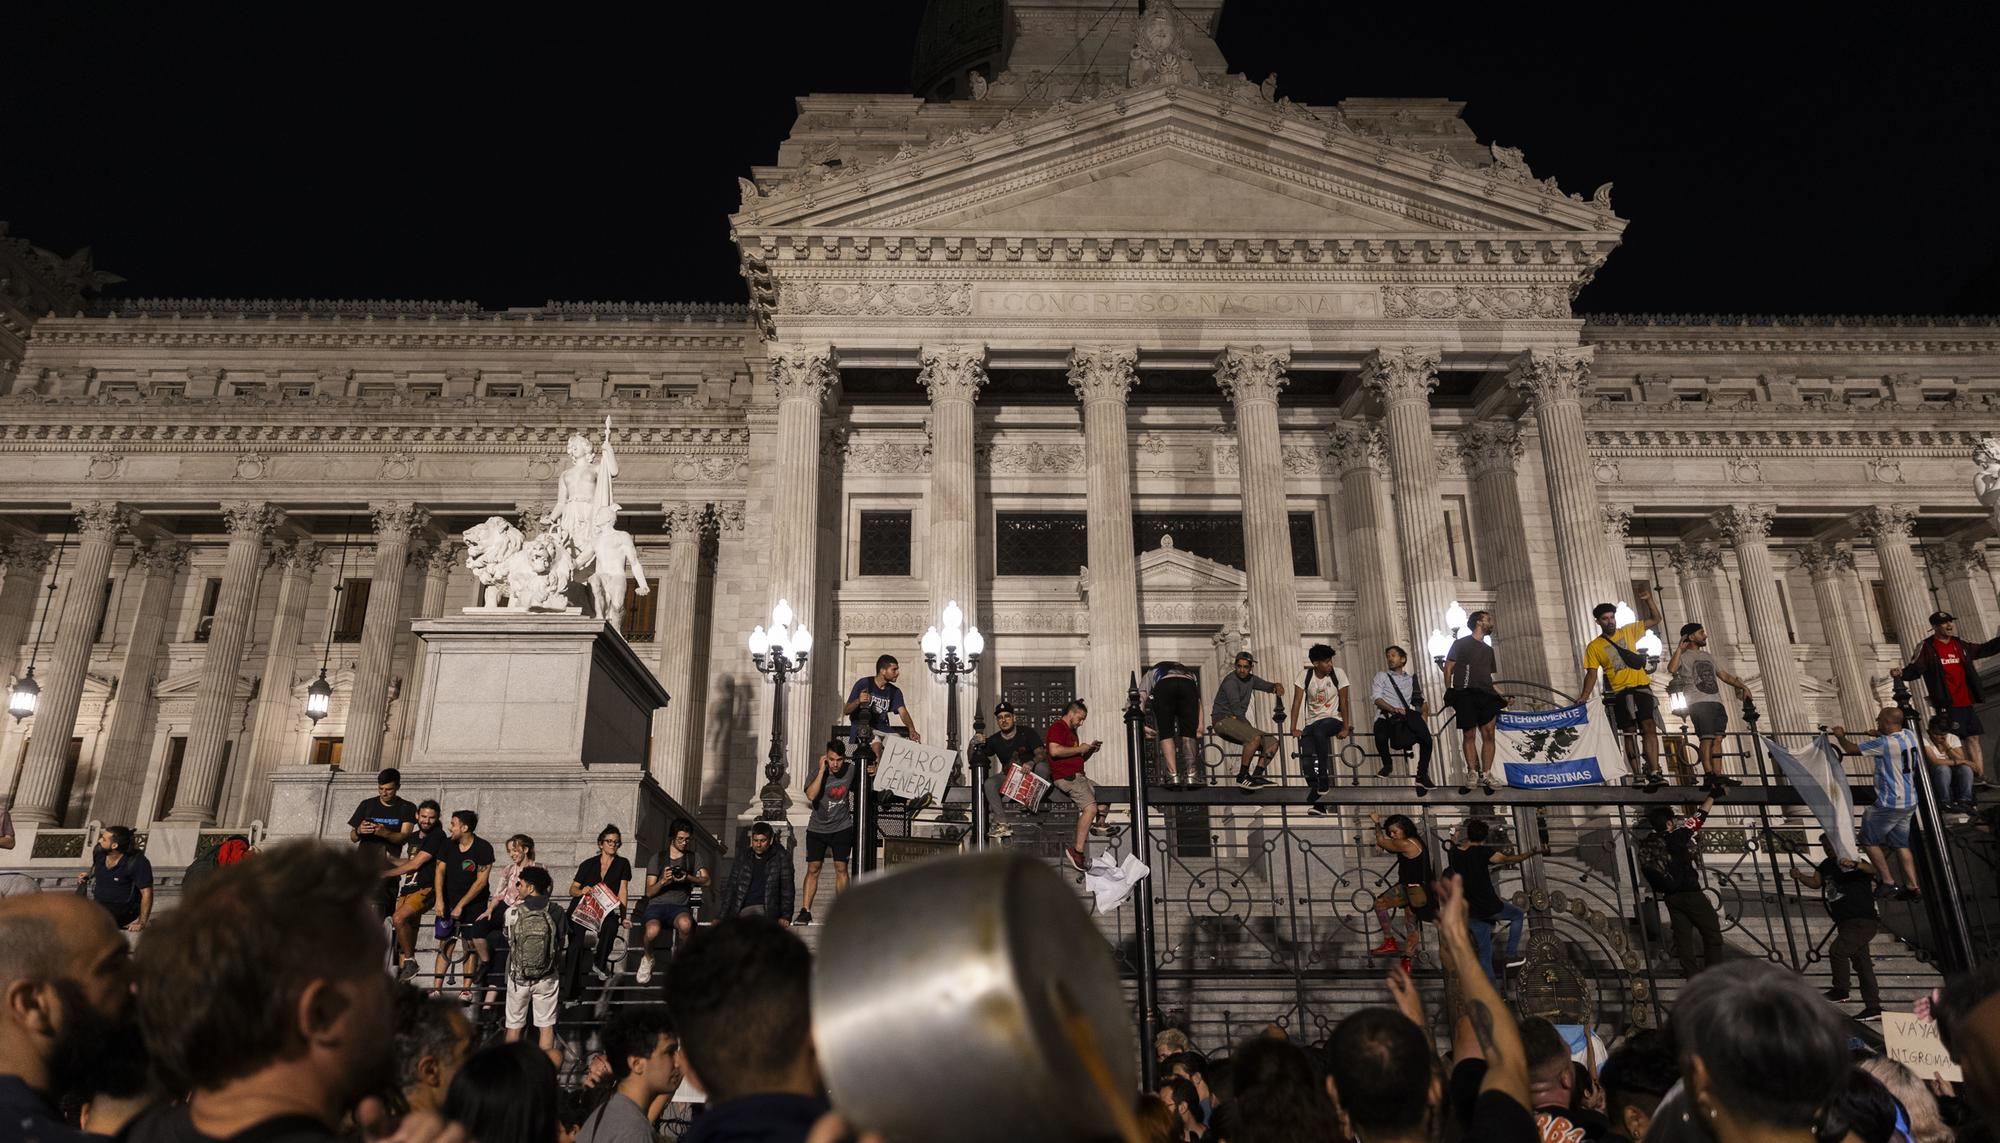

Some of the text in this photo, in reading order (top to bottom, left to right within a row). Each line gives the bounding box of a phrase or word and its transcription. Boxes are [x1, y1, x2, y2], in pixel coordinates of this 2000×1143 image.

[1003, 293, 1353, 314] CONGRESO NACIONAL
[1501, 708, 1580, 724] ETERNAMENTE
[888, 743, 946, 774] PARO
[880, 765, 938, 800] GENERAL
[1524, 770, 1592, 785] ARGENTINAS
[1890, 1047, 1952, 1068] NIGROMA
